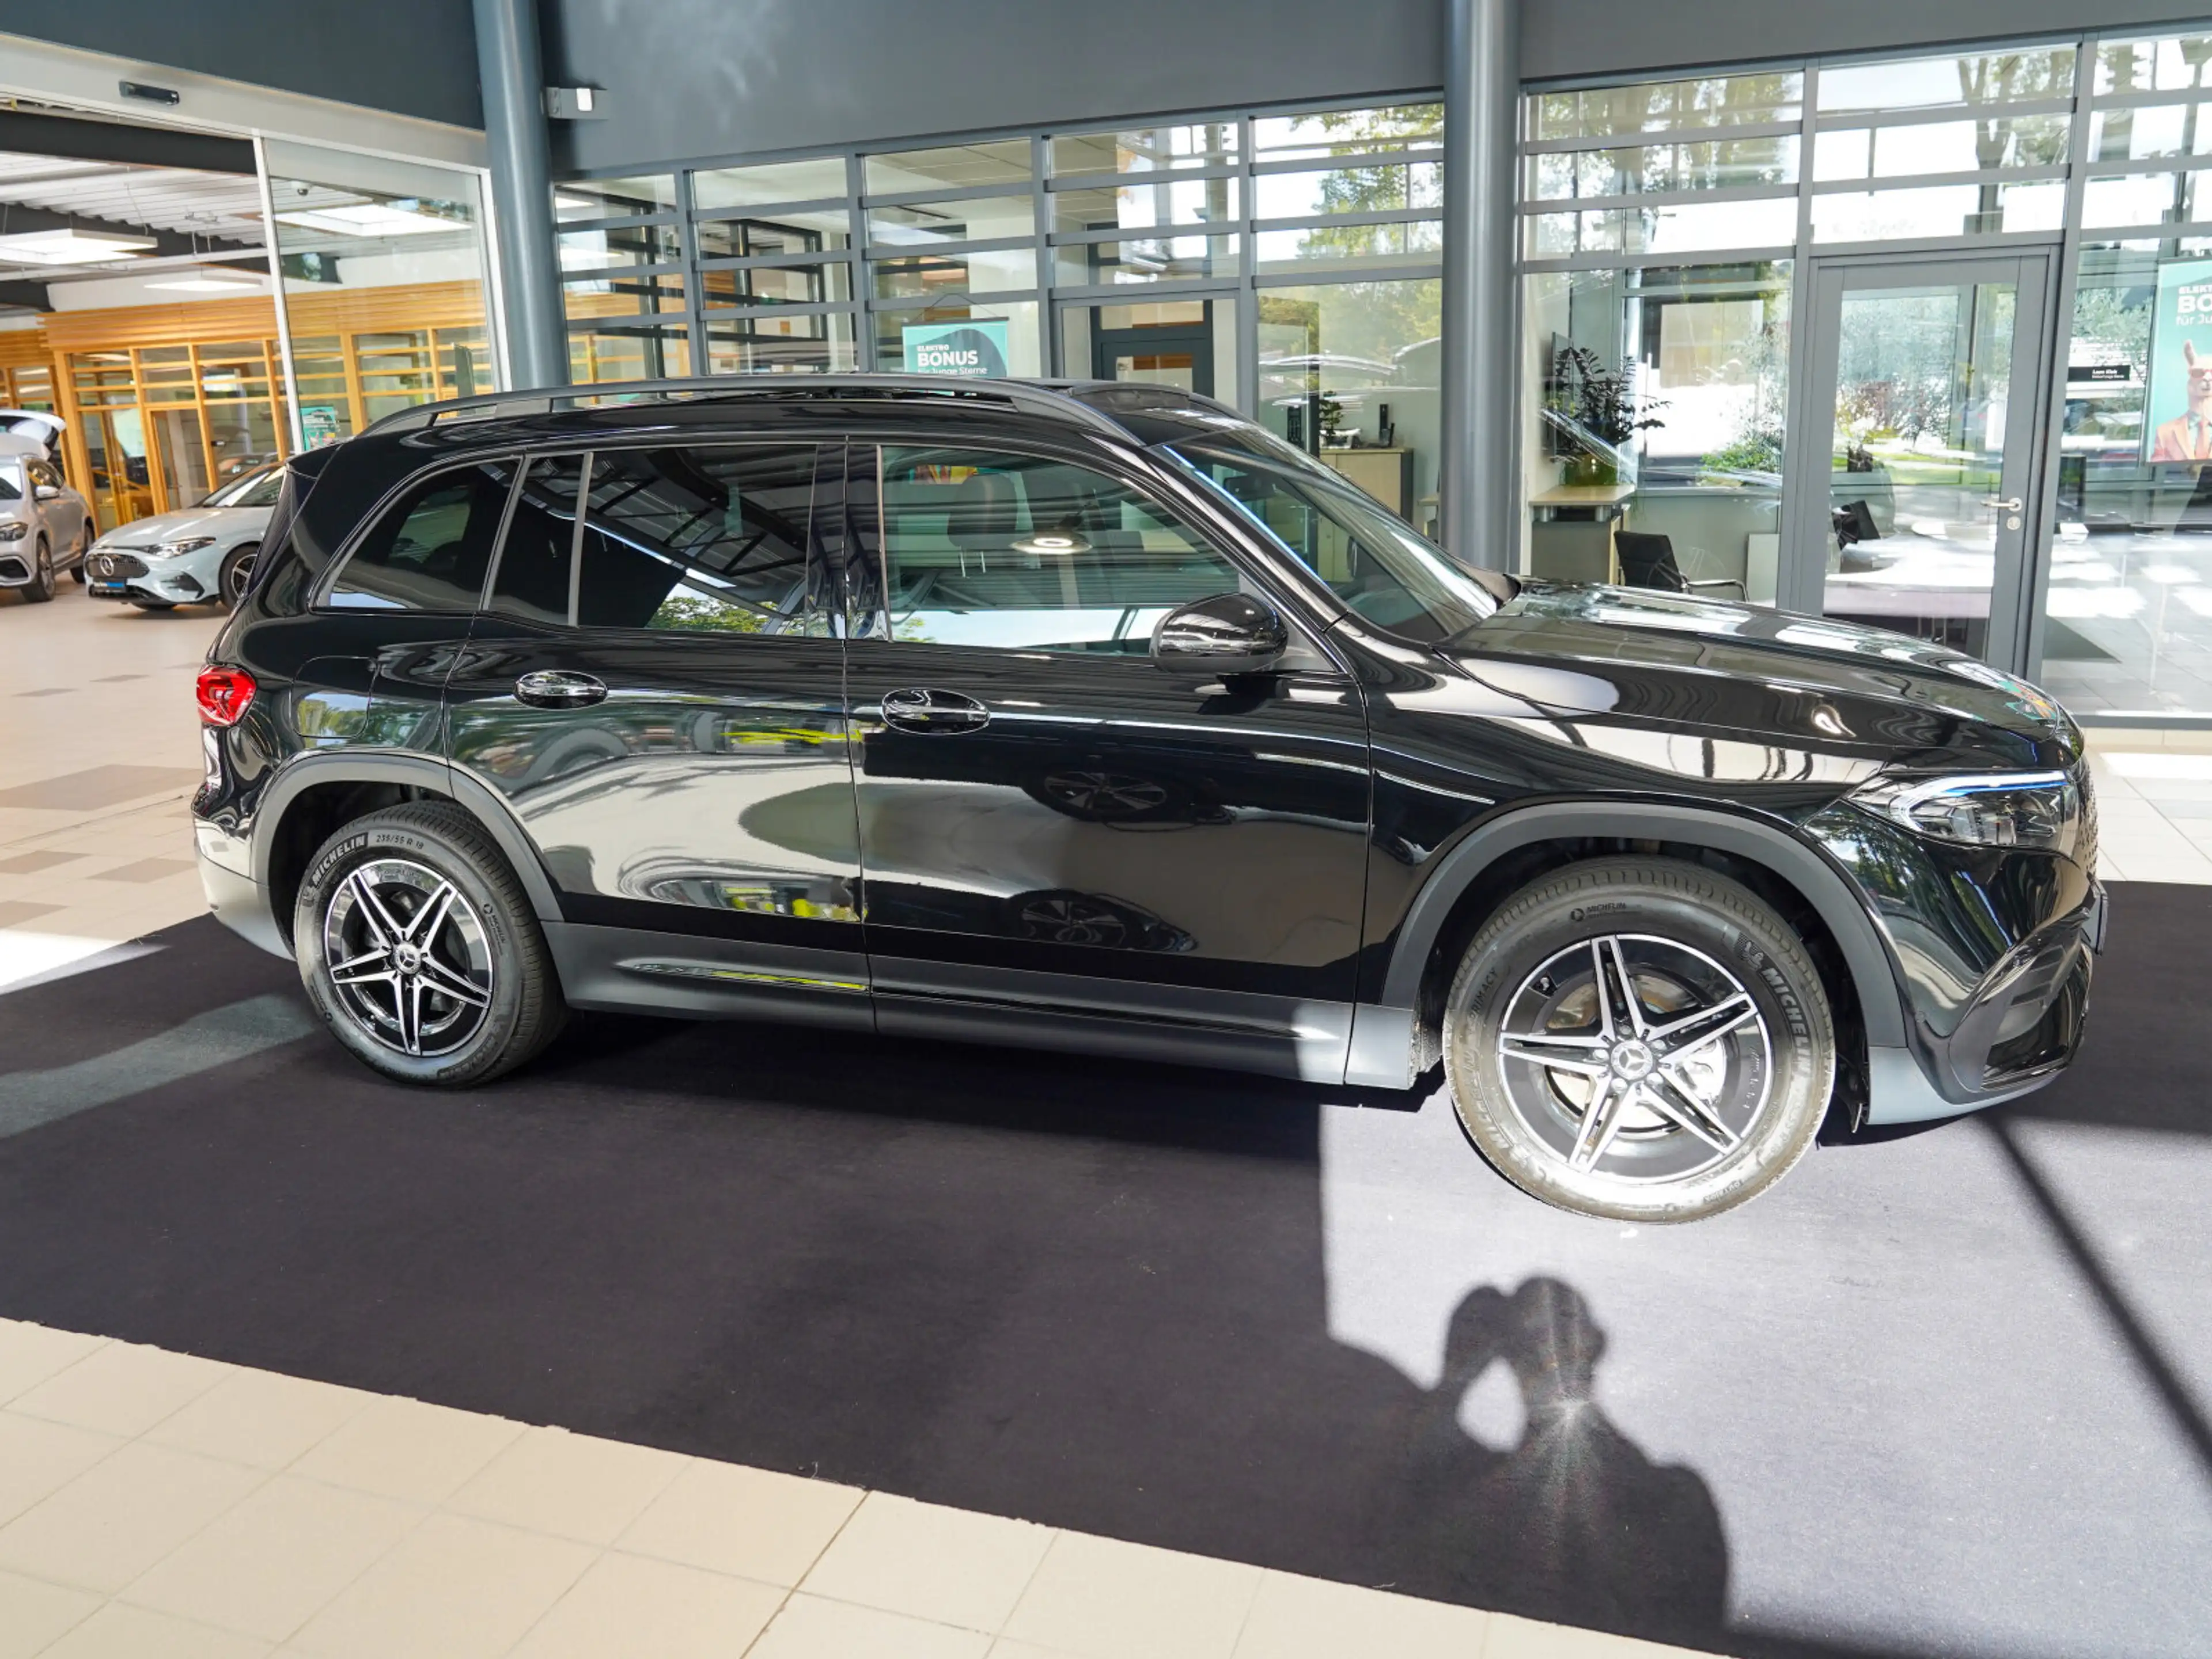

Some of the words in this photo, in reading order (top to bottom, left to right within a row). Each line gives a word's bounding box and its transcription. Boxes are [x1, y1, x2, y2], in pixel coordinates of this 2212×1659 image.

[2177, 294, 2212, 313] BO
[918, 350, 978, 367] BONUS
[959, 366, 988, 375] Sterne
[312, 835, 365, 885] MICHELIN
[1469, 967, 1497, 1019] PRIMACY
[1762, 967, 1811, 1075] MICHELIN
